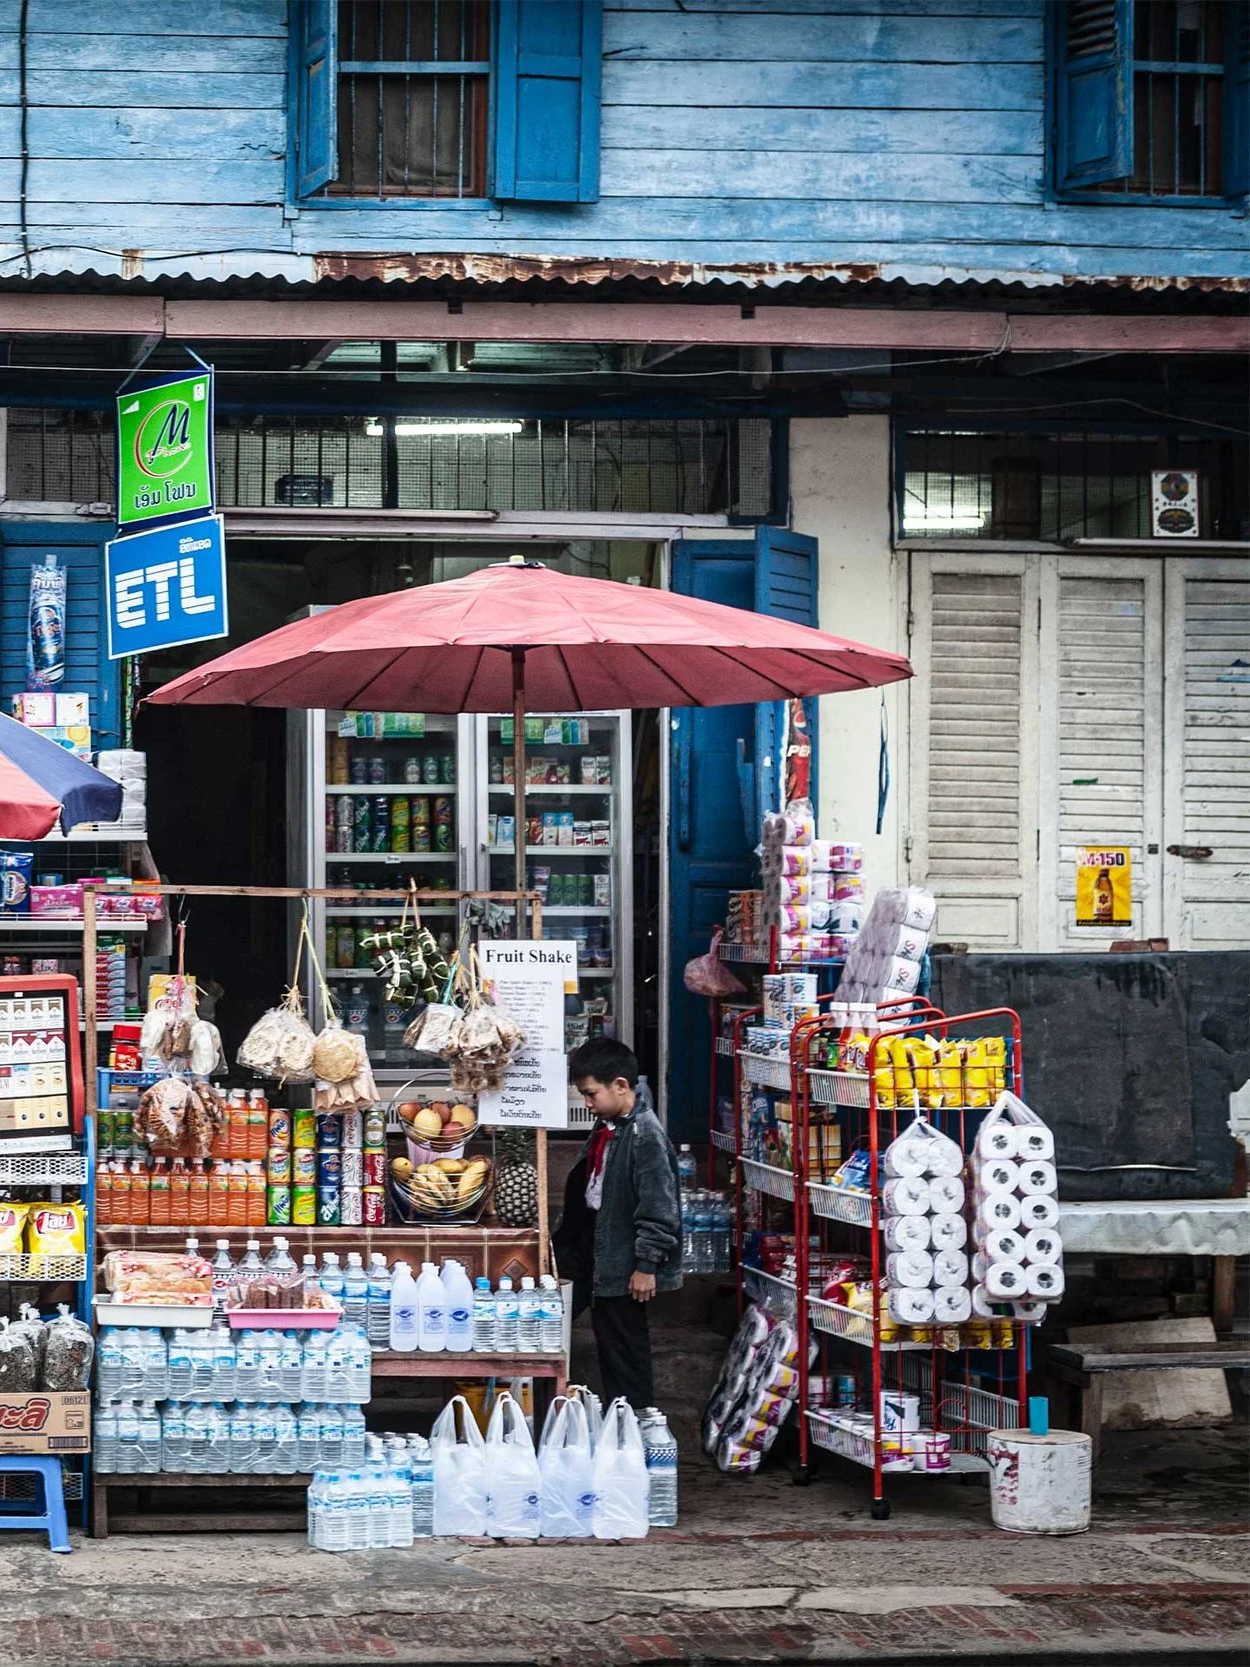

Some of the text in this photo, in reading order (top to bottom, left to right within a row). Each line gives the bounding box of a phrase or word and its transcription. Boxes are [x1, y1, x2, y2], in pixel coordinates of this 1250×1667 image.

[115, 557, 216, 629] ETL
[486, 949, 572, 964] Fruit Shake
